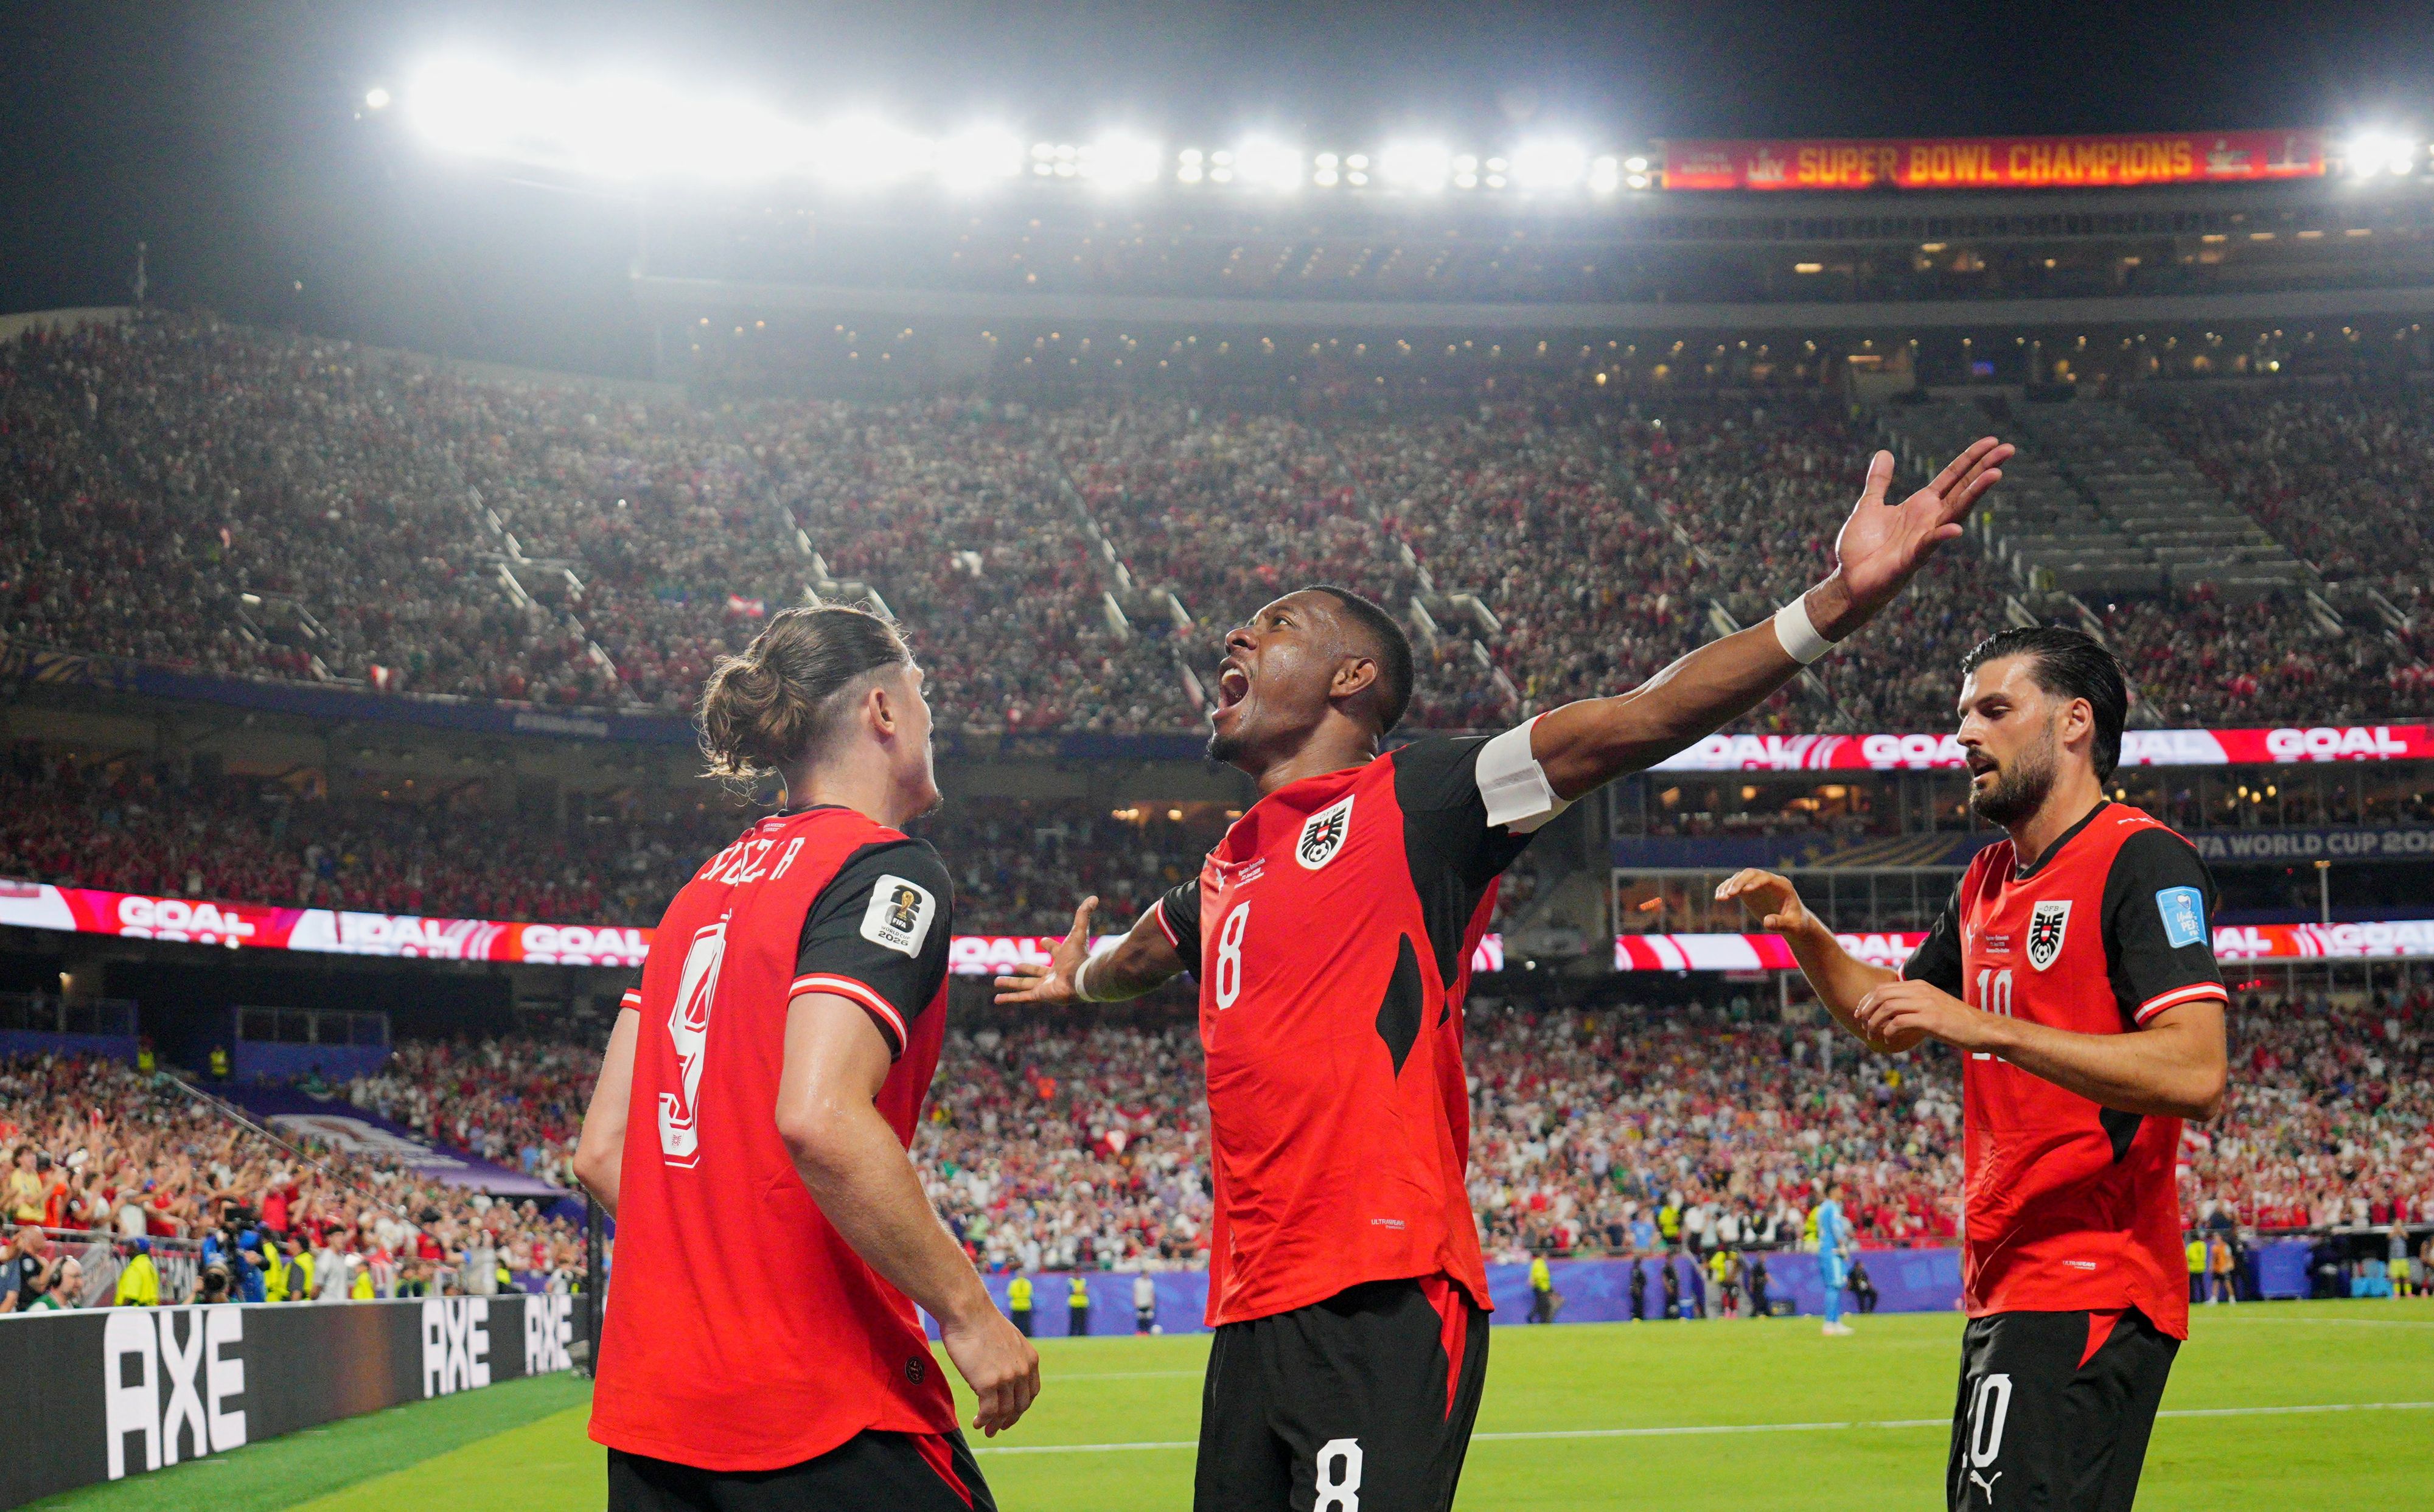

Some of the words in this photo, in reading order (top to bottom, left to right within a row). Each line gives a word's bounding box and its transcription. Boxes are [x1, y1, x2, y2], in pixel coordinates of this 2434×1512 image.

[1798, 147, 1898, 182] SUPER
[1909, 145, 1998, 181] BOWL
[2009, 141, 2192, 180] CHAMPIONS
[2267, 726, 2407, 756] GOAL
[2230, 833, 2322, 855] WORLD
[2326, 831, 2379, 853] CUP
[118, 896, 255, 937] GOAL
[881, 925, 899, 936] WORLD
[892, 918, 907, 929] FIFA
[2328, 923, 2434, 950] GOA
[521, 924, 650, 957] GOAL
[878, 930, 909, 946] 2026
[949, 937, 1052, 964] OAL
[1216, 899, 1251, 1011] 8
[658, 908, 732, 1169] 9
[422, 1297, 490, 1399] AXE
[524, 1294, 573, 1376] AXE
[104, 1306, 246, 1481] AXE
[1962, 1373, 2012, 1468] 0
[1313, 1438, 1363, 1512] 8
